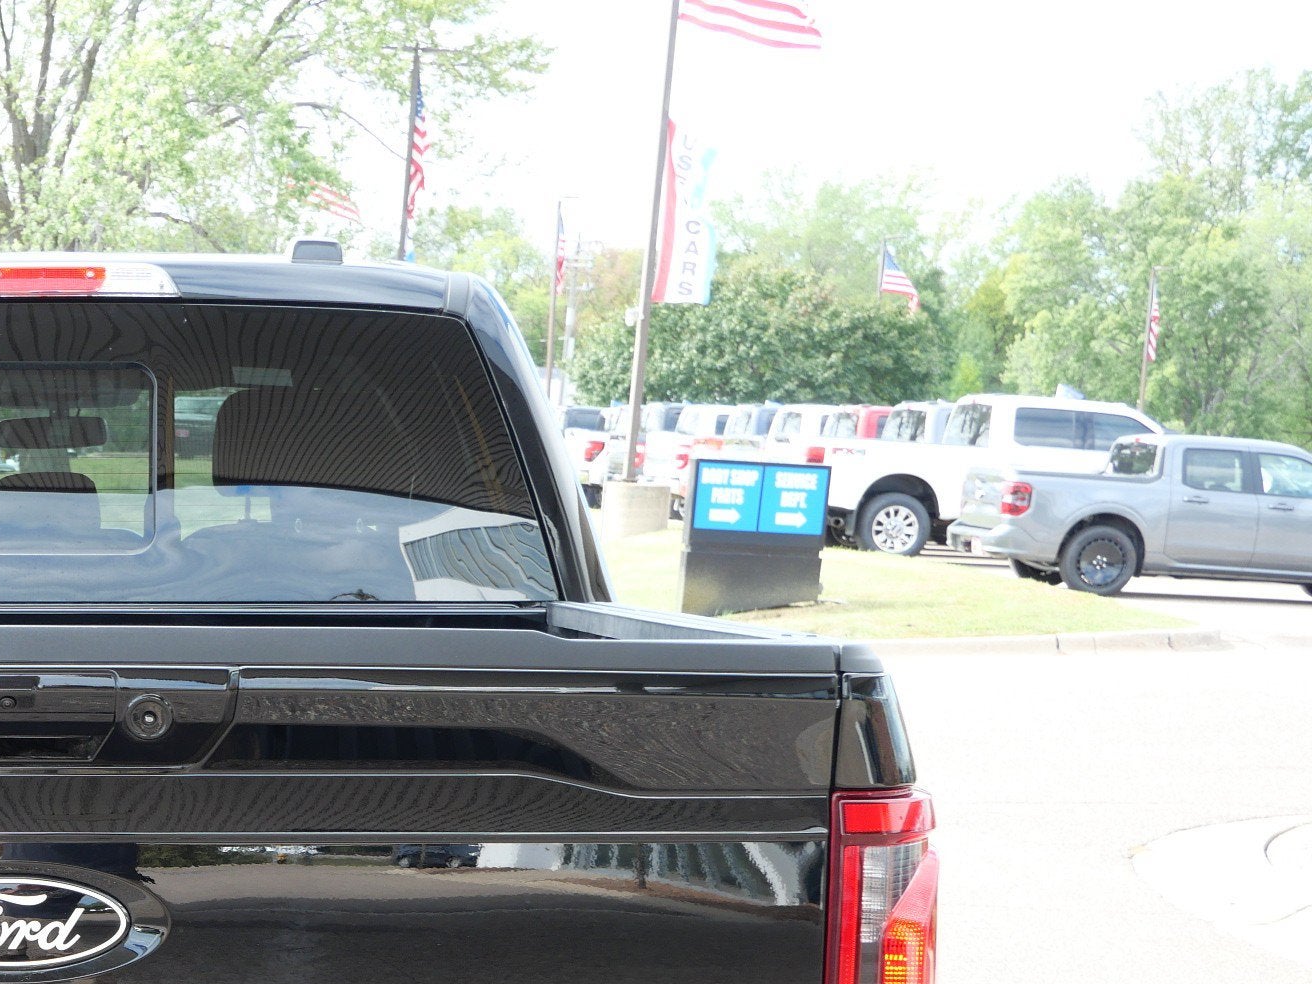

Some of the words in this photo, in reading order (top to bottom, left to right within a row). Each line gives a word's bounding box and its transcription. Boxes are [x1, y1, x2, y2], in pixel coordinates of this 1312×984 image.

[678, 220, 701, 296] CARS
[775, 471, 818, 490] SERVICE
[711, 487, 745, 505] PARTS
